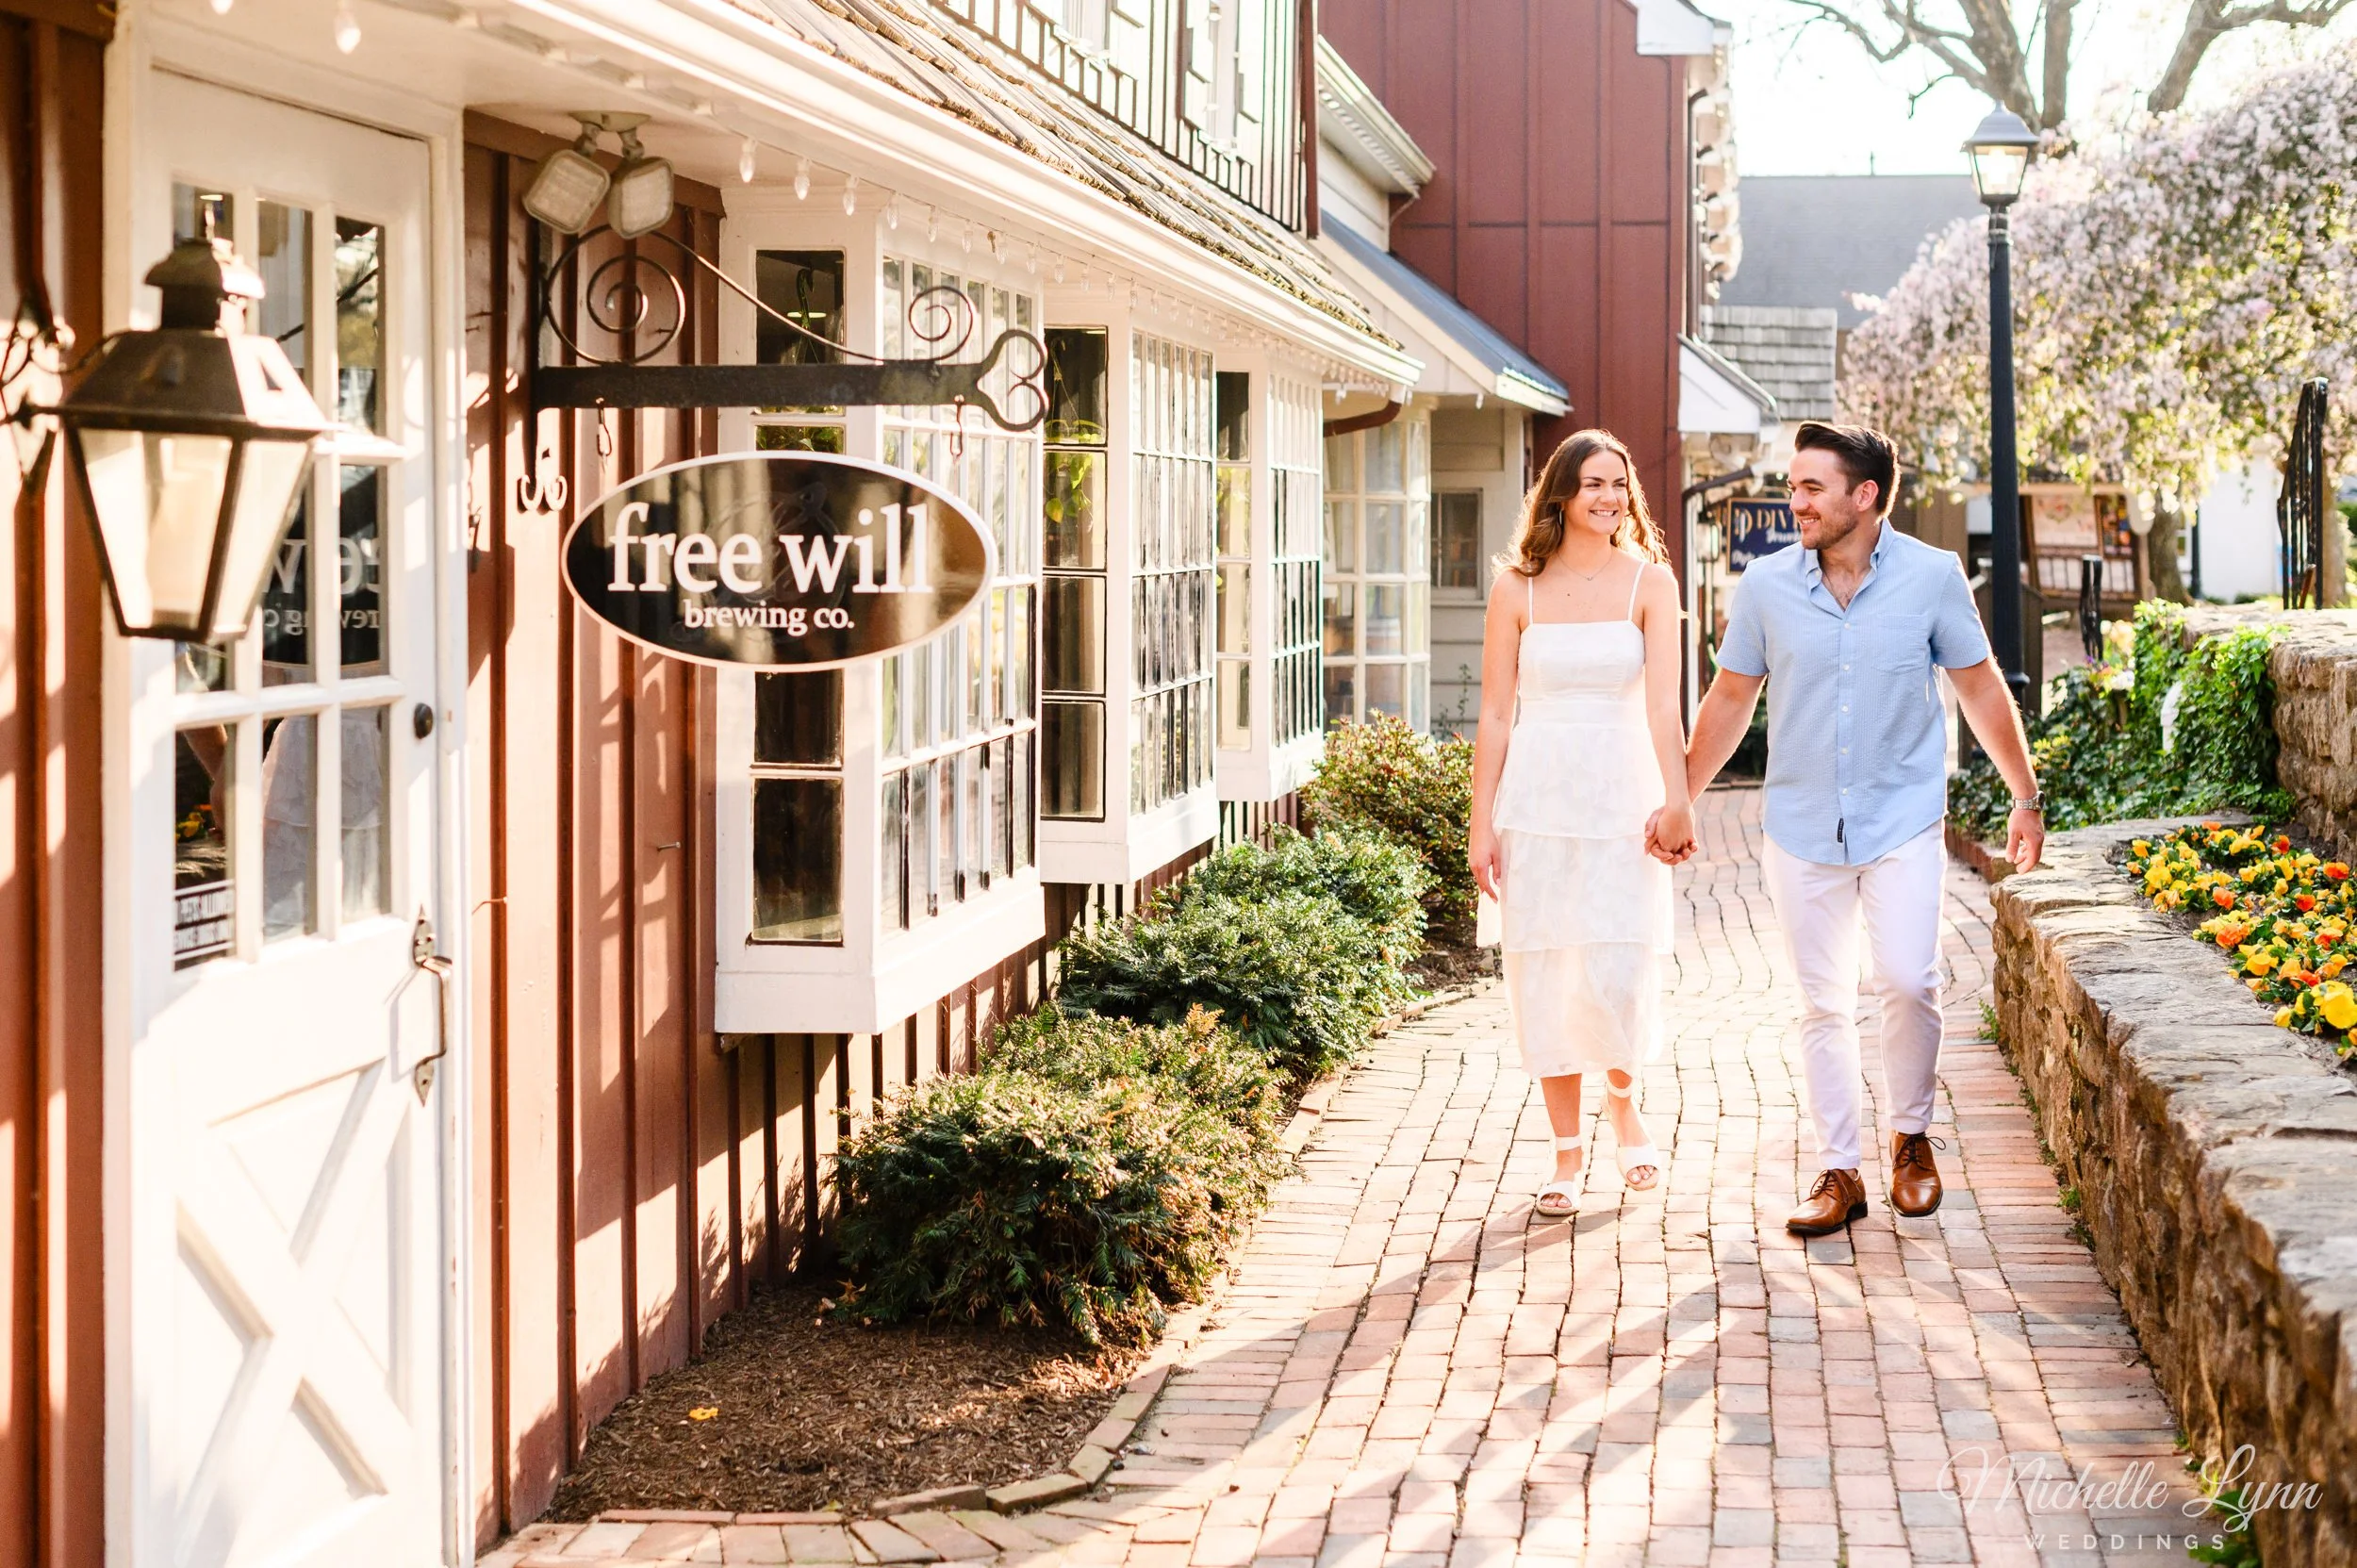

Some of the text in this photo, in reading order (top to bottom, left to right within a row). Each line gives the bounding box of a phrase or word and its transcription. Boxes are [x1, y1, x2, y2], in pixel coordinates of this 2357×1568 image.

[607, 502, 933, 594] free will
[684, 599, 854, 636] brewing co.
